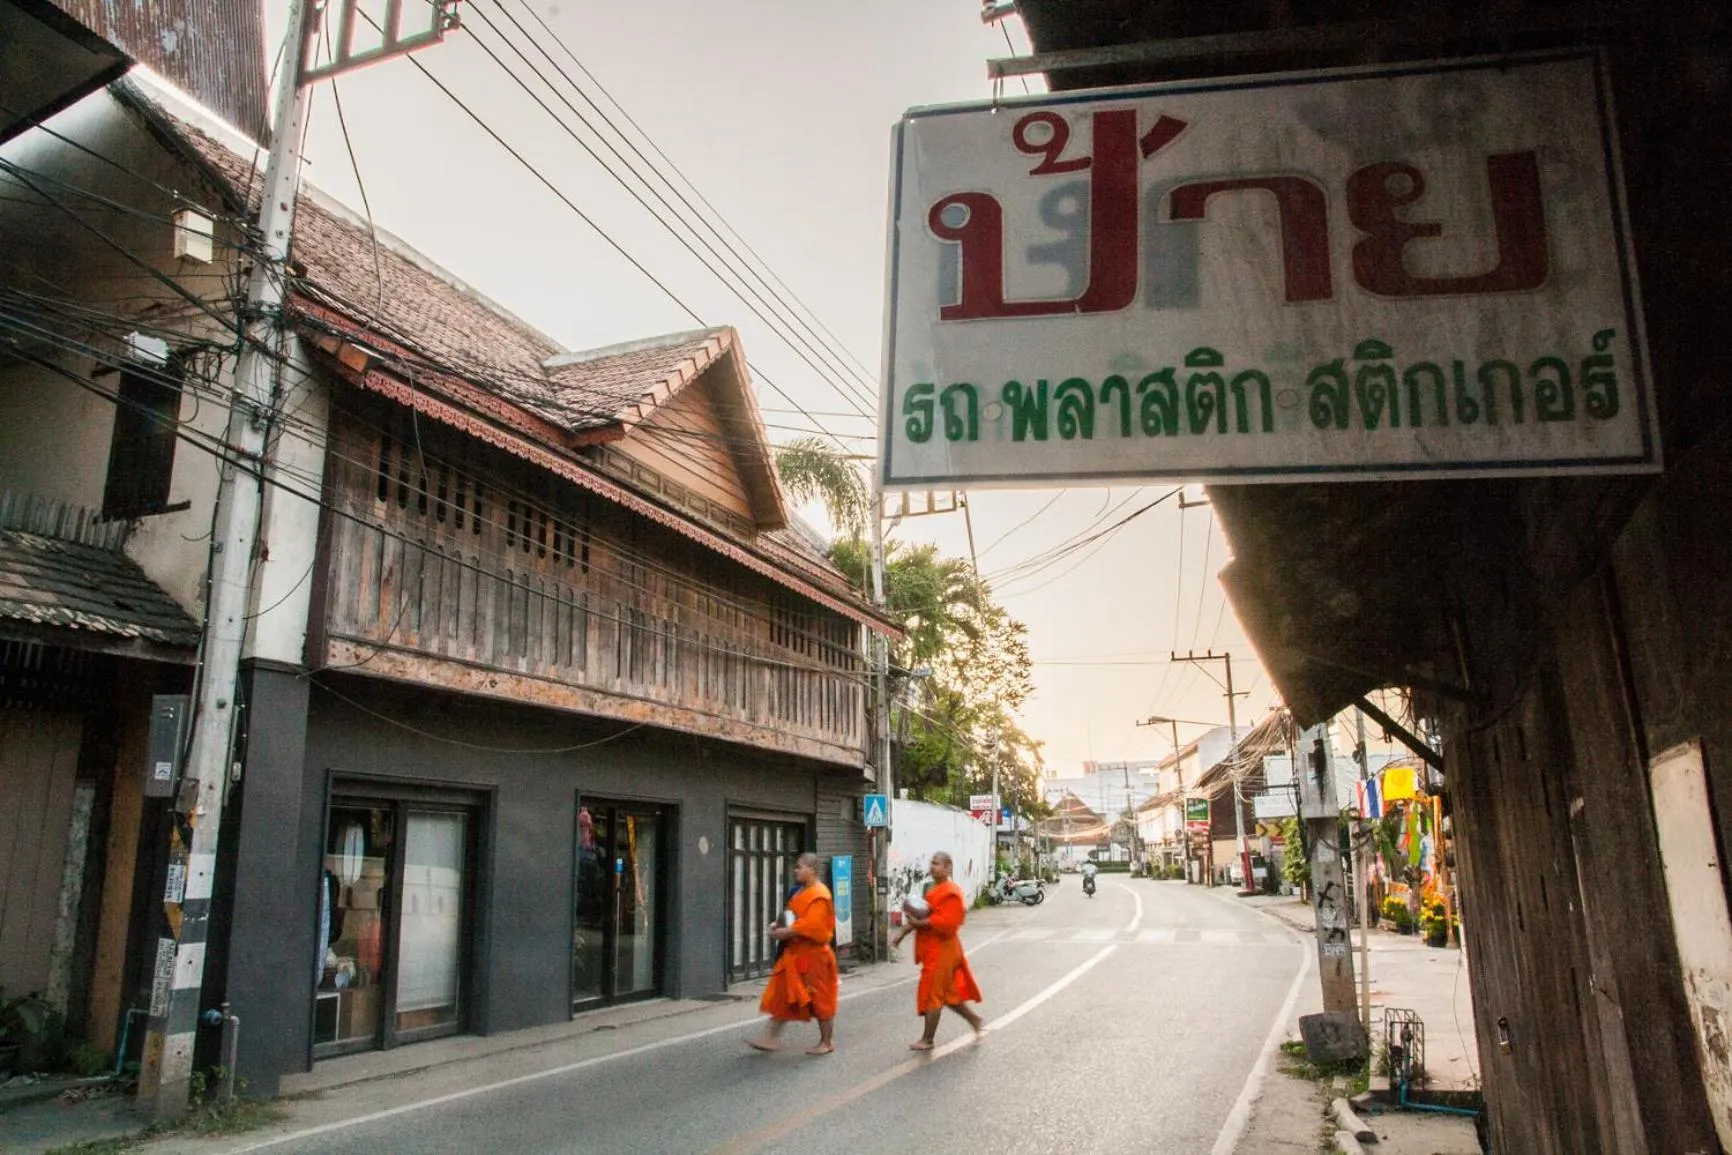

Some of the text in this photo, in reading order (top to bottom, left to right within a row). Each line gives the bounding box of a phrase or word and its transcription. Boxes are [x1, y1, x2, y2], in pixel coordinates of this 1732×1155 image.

[927, 109, 1550, 321] ป้าย
[902, 328, 1620, 443] รถ พลาสติก สติกเกอร์
